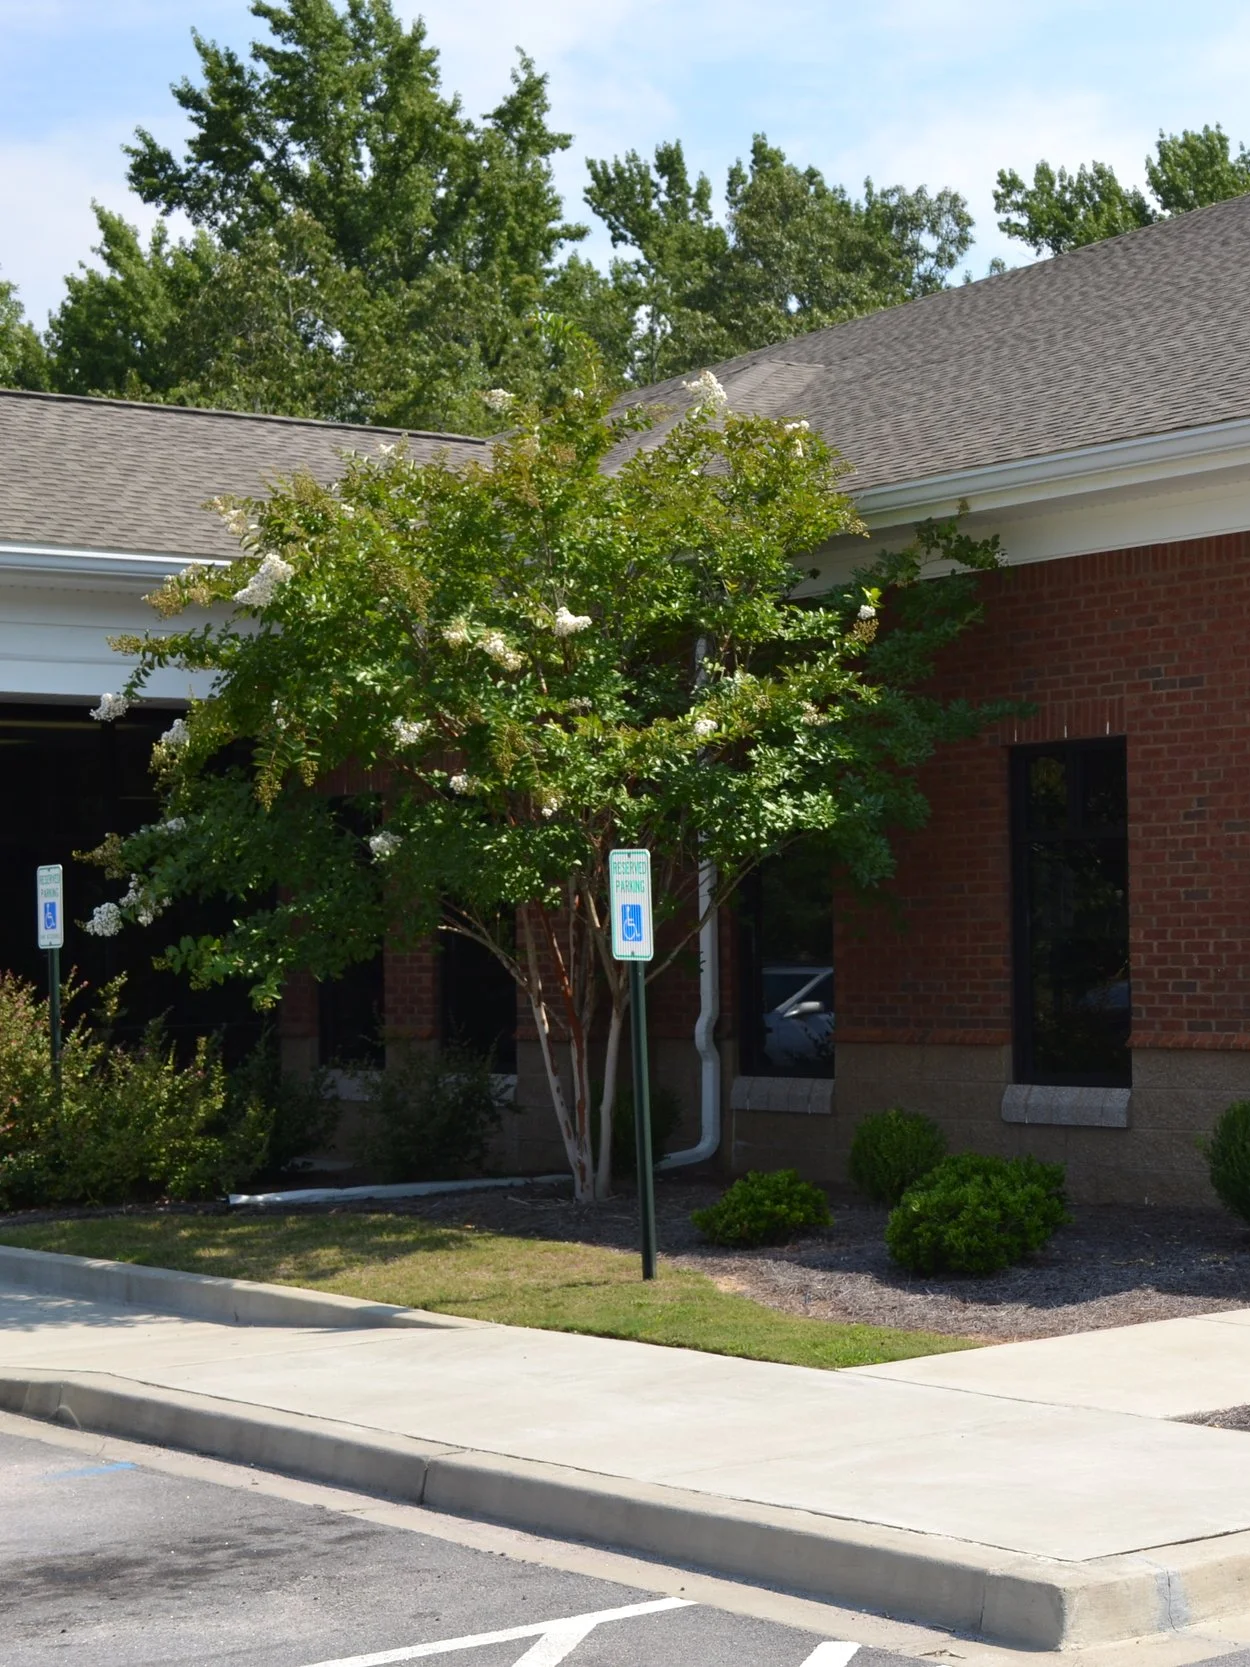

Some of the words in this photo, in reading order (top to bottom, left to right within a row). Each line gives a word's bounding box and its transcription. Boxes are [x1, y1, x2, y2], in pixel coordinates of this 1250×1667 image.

[613, 861, 647, 875] RESERVED
[40, 874, 60, 884] RESERVED
[616, 879, 645, 893] PARKING
[41, 888, 60, 898] PARKING
